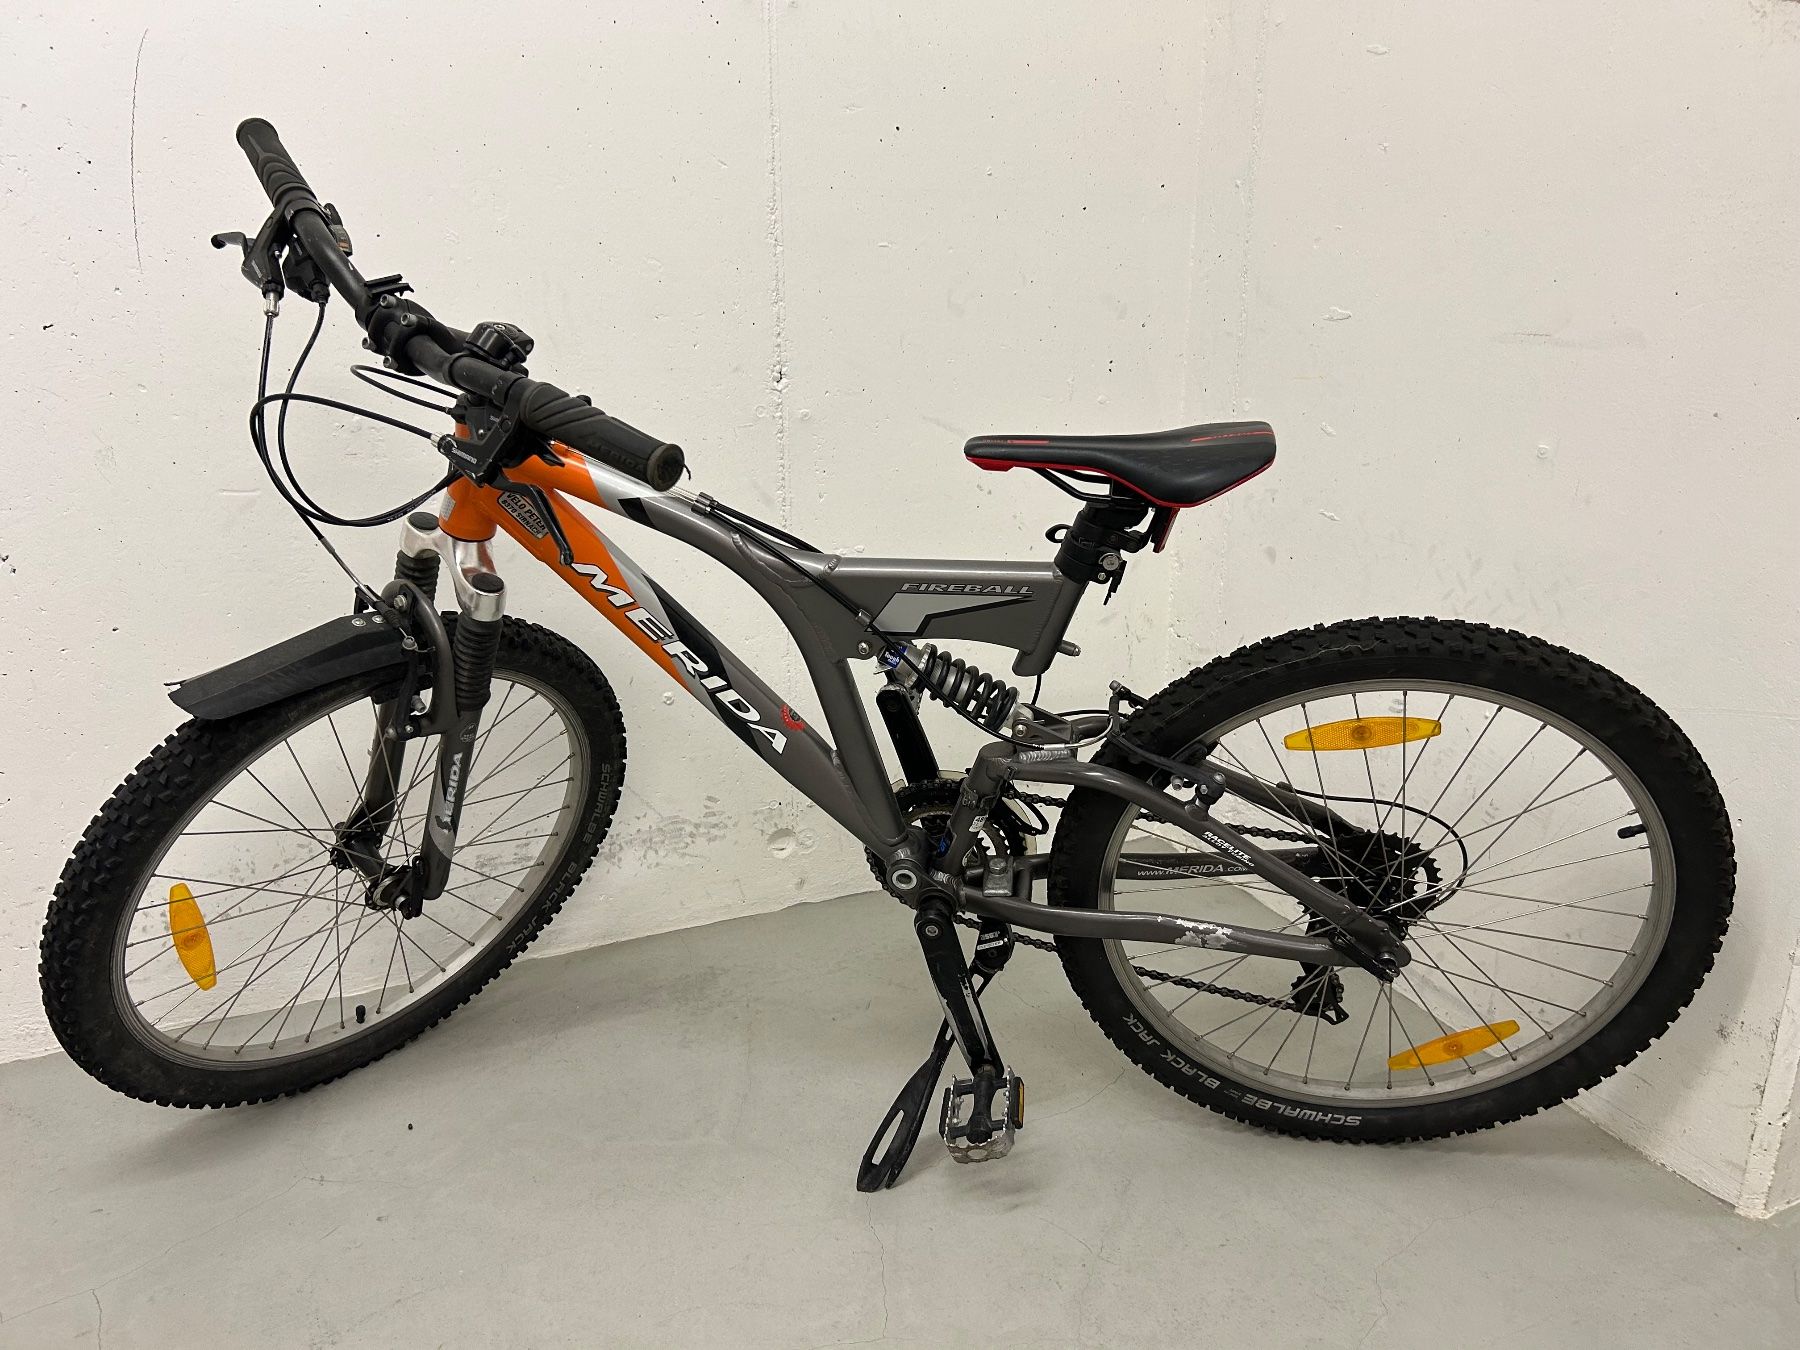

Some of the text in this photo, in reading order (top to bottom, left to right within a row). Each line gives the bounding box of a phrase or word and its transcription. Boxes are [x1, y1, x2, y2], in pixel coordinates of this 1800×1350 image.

[524, 508, 546, 531] PETER
[900, 583, 1033, 594] FIREBALL
[570, 562, 788, 754] MERIDA
[506, 763, 611, 953] SCHWALBE BLACK JACK
[1203, 831, 1252, 861] RACELITE
[1122, 1013, 1363, 1126] SCHWALBE BLACK JACK
